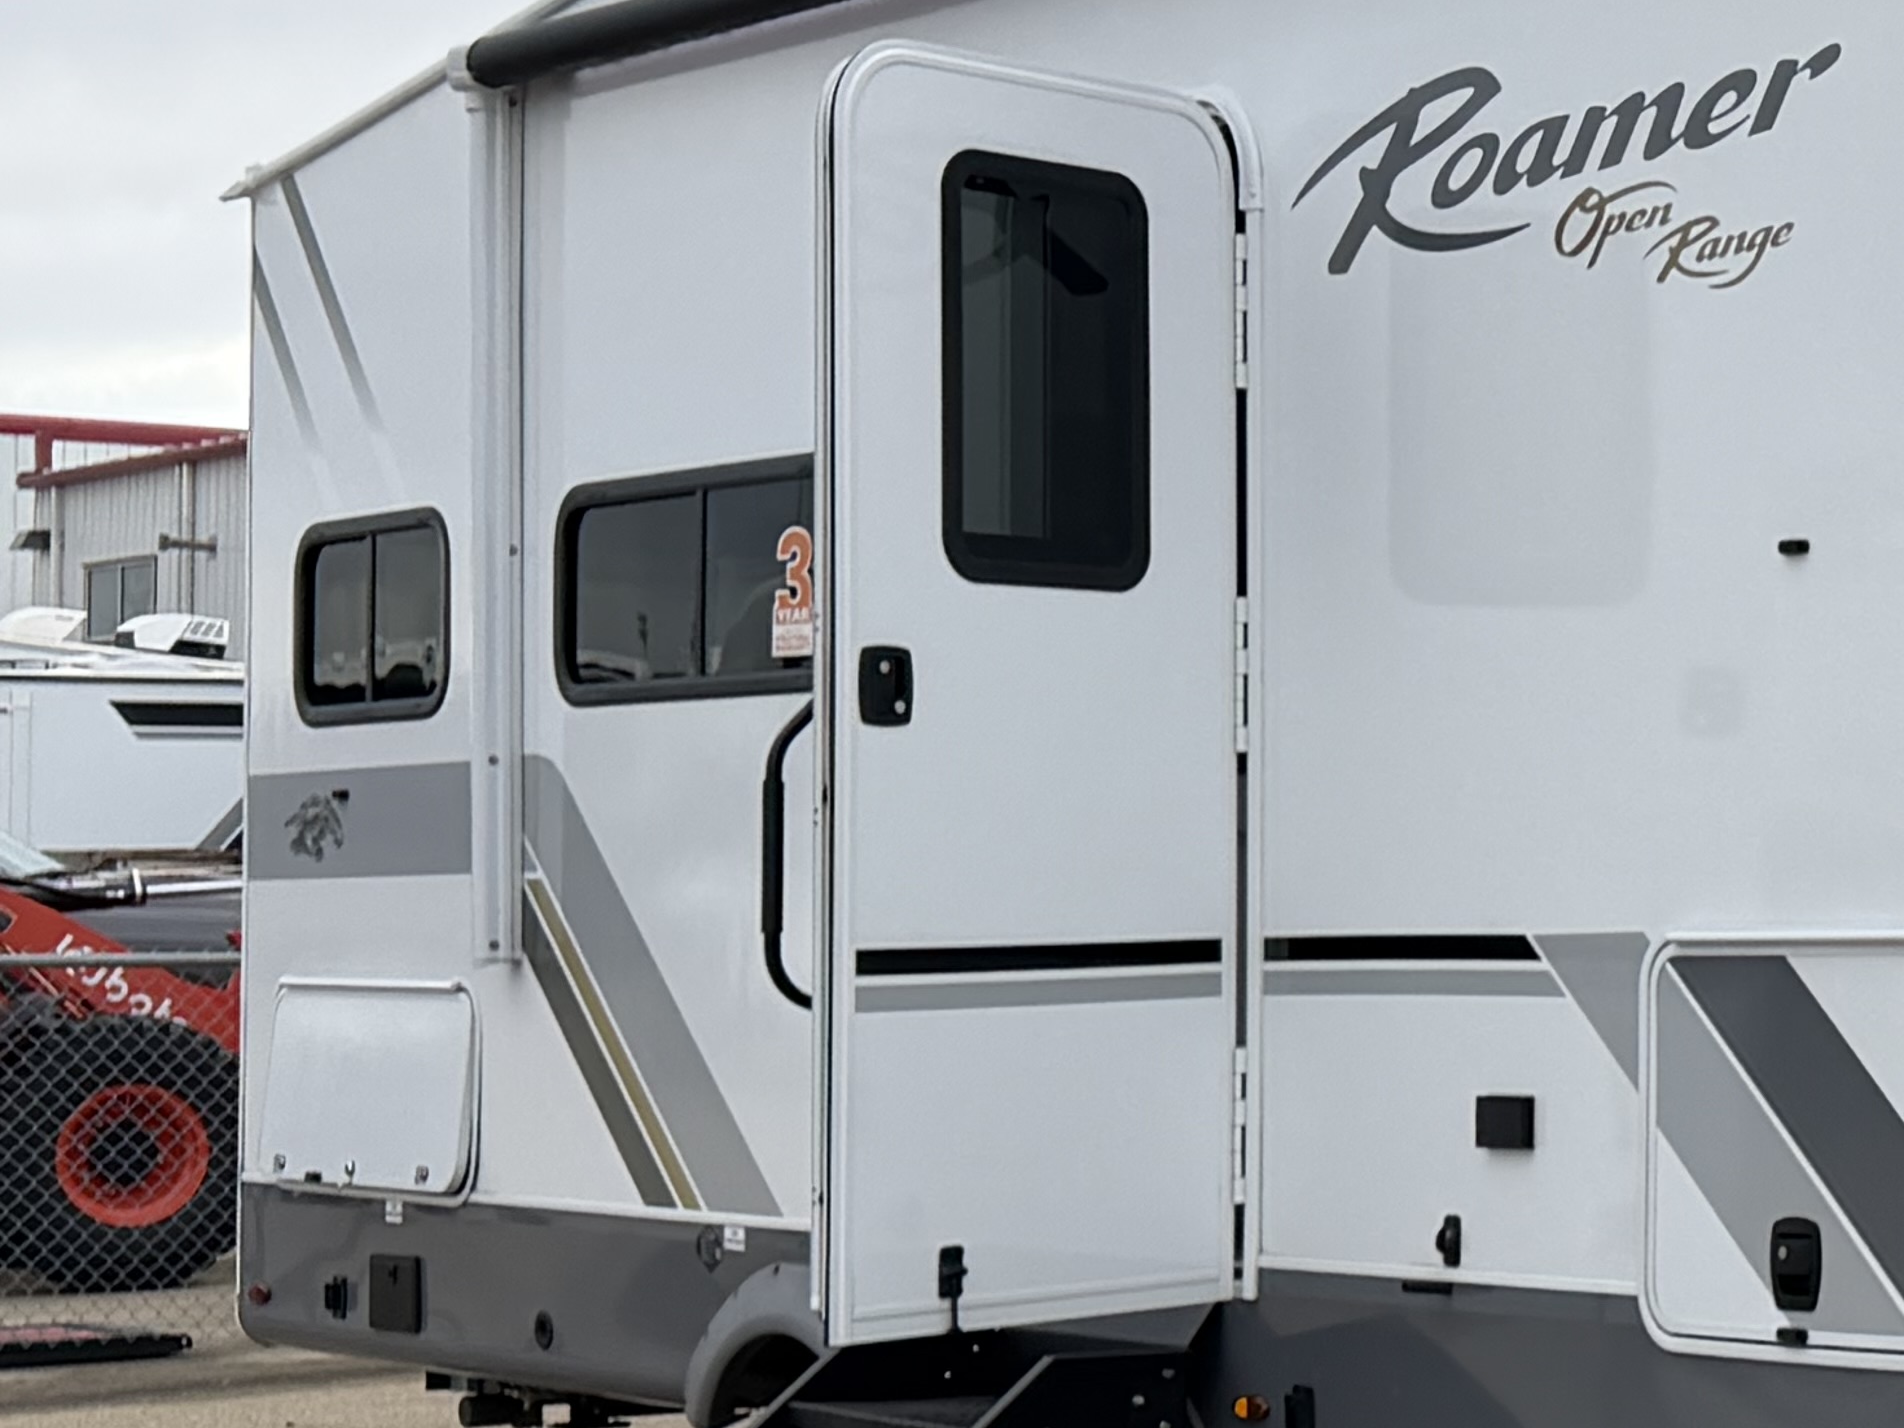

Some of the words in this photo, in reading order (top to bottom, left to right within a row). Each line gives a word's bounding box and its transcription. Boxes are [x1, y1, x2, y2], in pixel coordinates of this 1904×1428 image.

[1291, 42, 1842, 275] Roamer
[1554, 181, 1678, 270] Open
[1643, 215, 1795, 290] Range
[775, 525, 813, 609] 3
